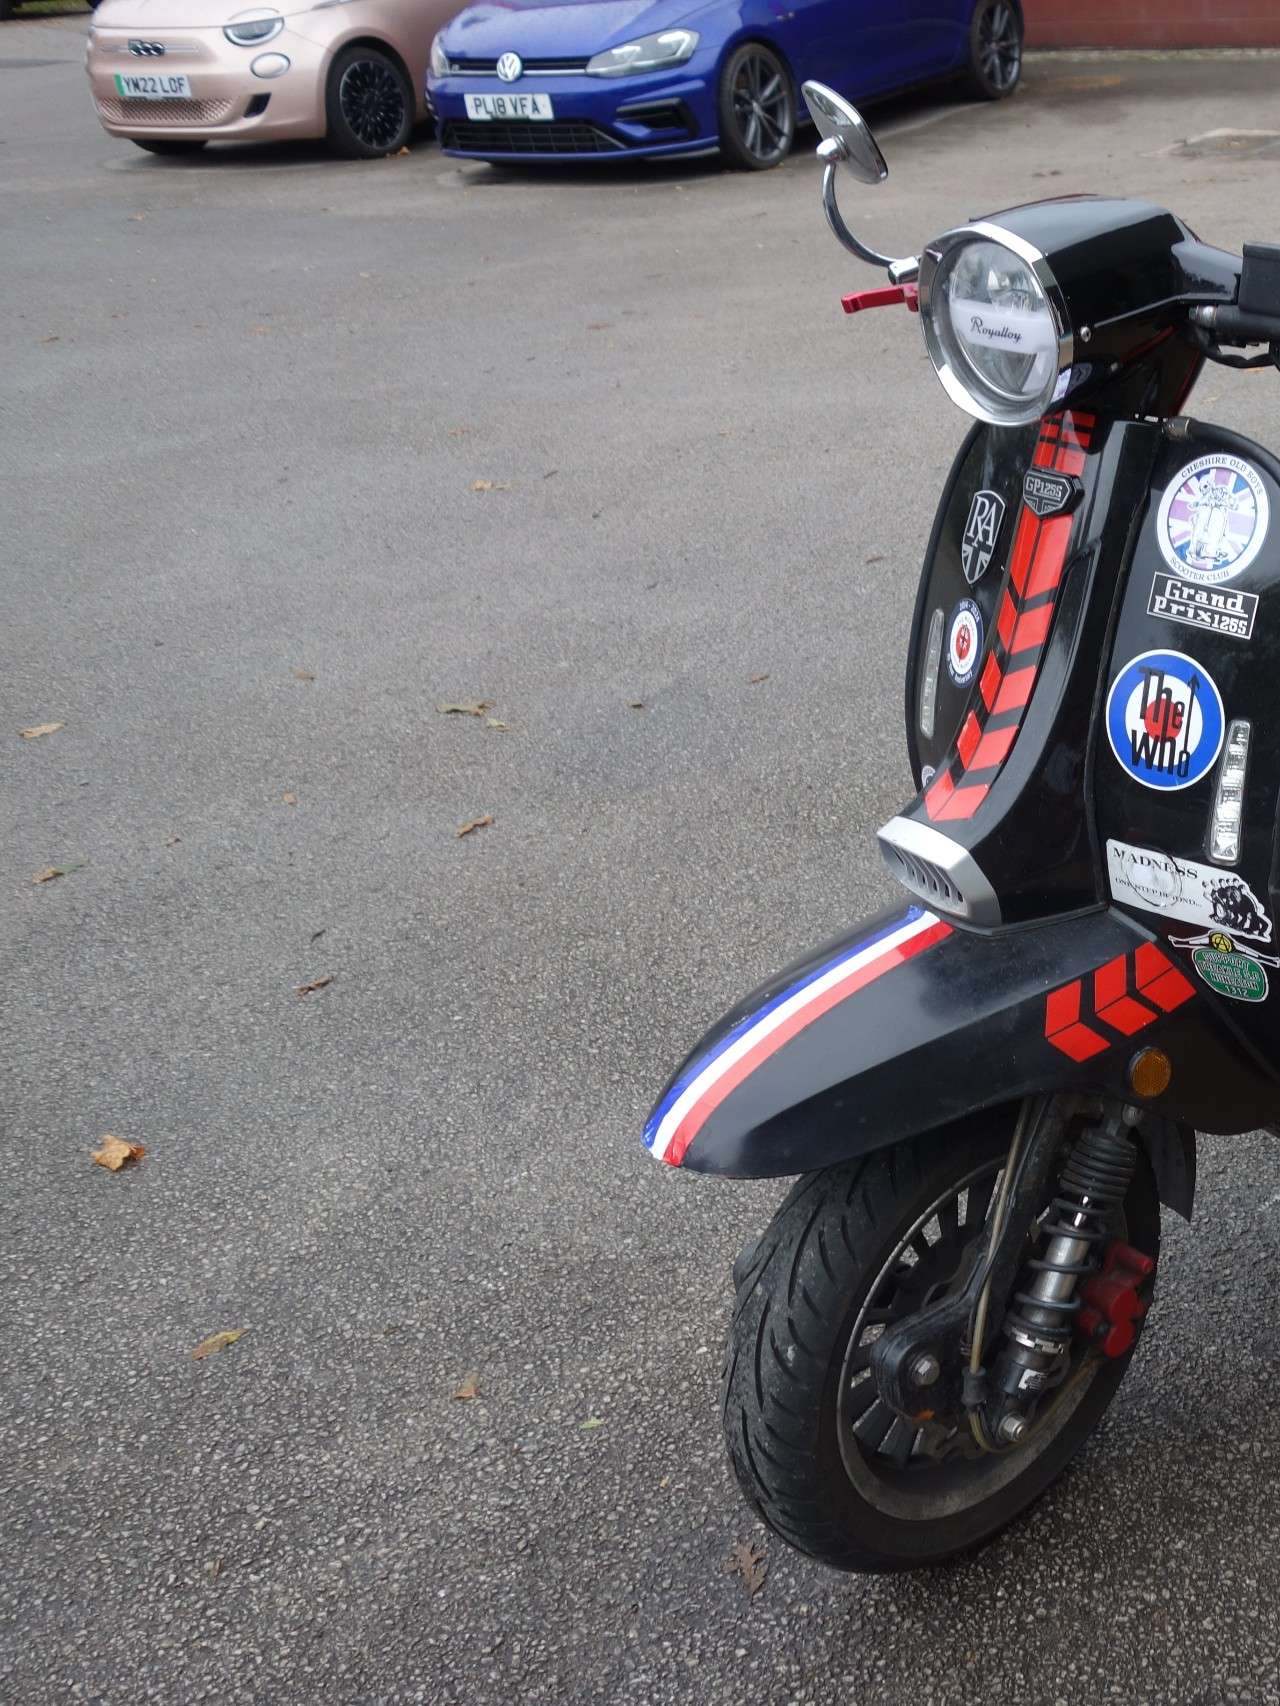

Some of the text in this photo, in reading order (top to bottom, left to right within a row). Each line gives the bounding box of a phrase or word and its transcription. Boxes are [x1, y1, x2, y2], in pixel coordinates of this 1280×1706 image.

[473, 97, 540, 114] PL18 VFA
[970, 315, 1022, 344] Royalloy
[1181, 456, 1228, 478] CHESHIRE
[1229, 456, 1247, 473] OLD
[1025, 476, 1063, 499] GP125S
[1164, 579, 1246, 614] Grand
[1138, 665, 1186, 730] The
[1131, 729, 1191, 778] Who
[1113, 847, 1198, 879] MADNESS
